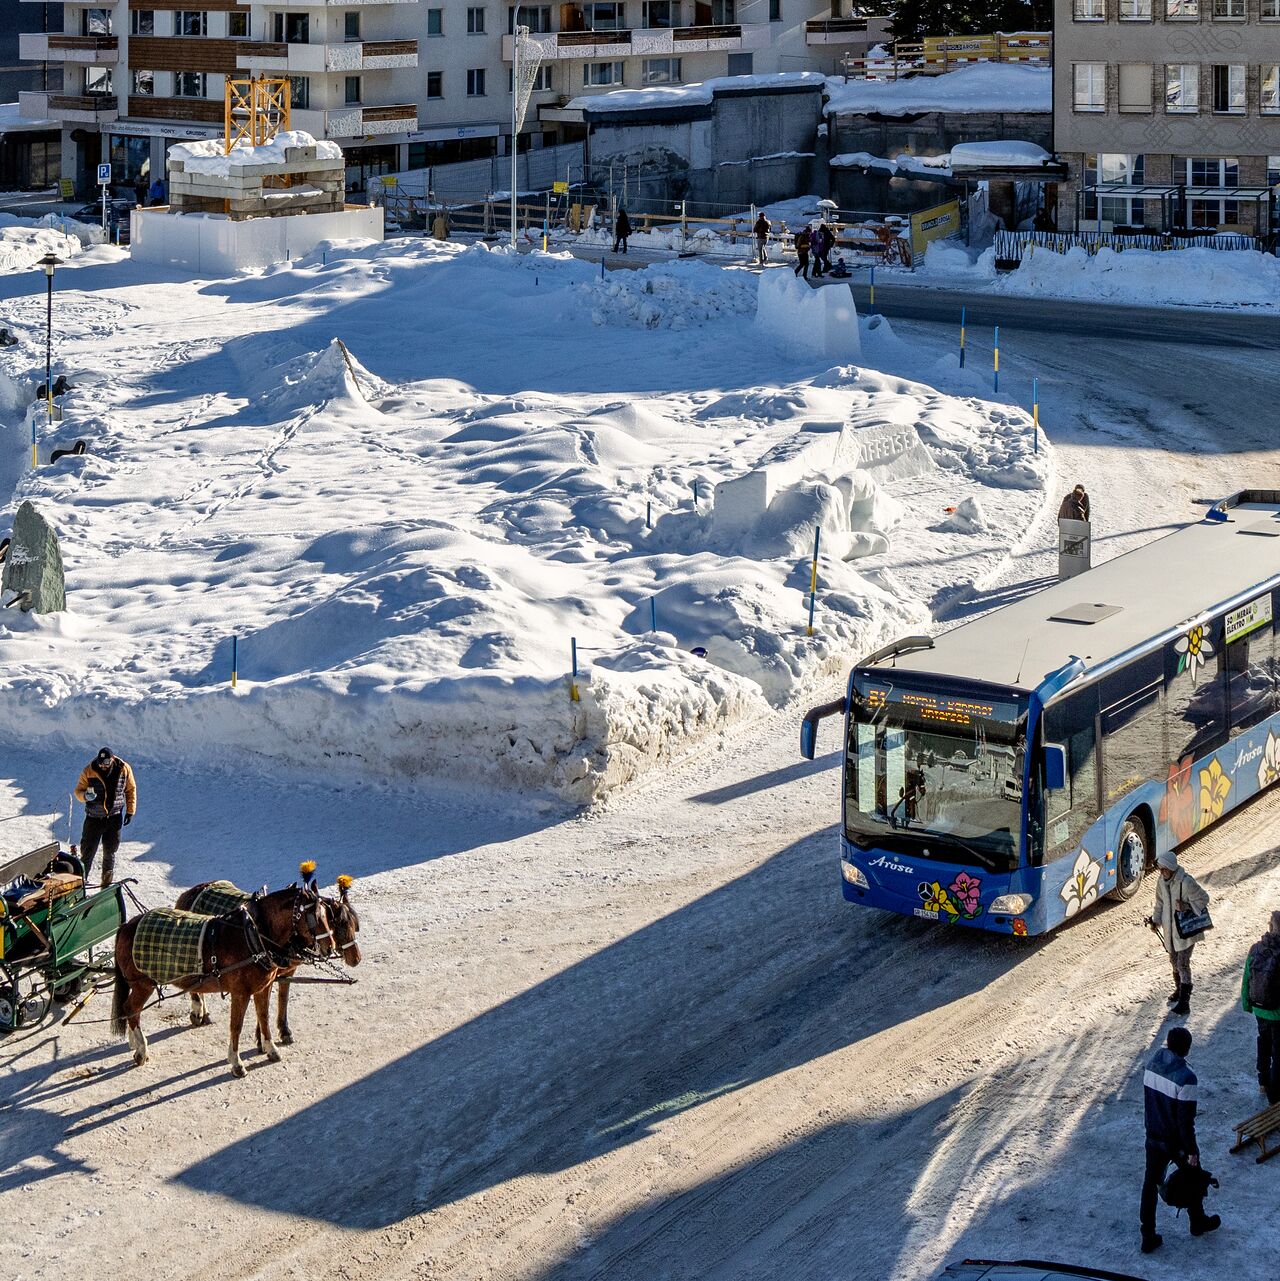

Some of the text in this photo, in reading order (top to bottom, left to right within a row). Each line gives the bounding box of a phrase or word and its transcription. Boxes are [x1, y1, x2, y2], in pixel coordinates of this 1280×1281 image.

[100, 166, 107, 177] P
[1231, 745, 1263, 774] Arosa
[868, 856, 914, 874] Arosa
